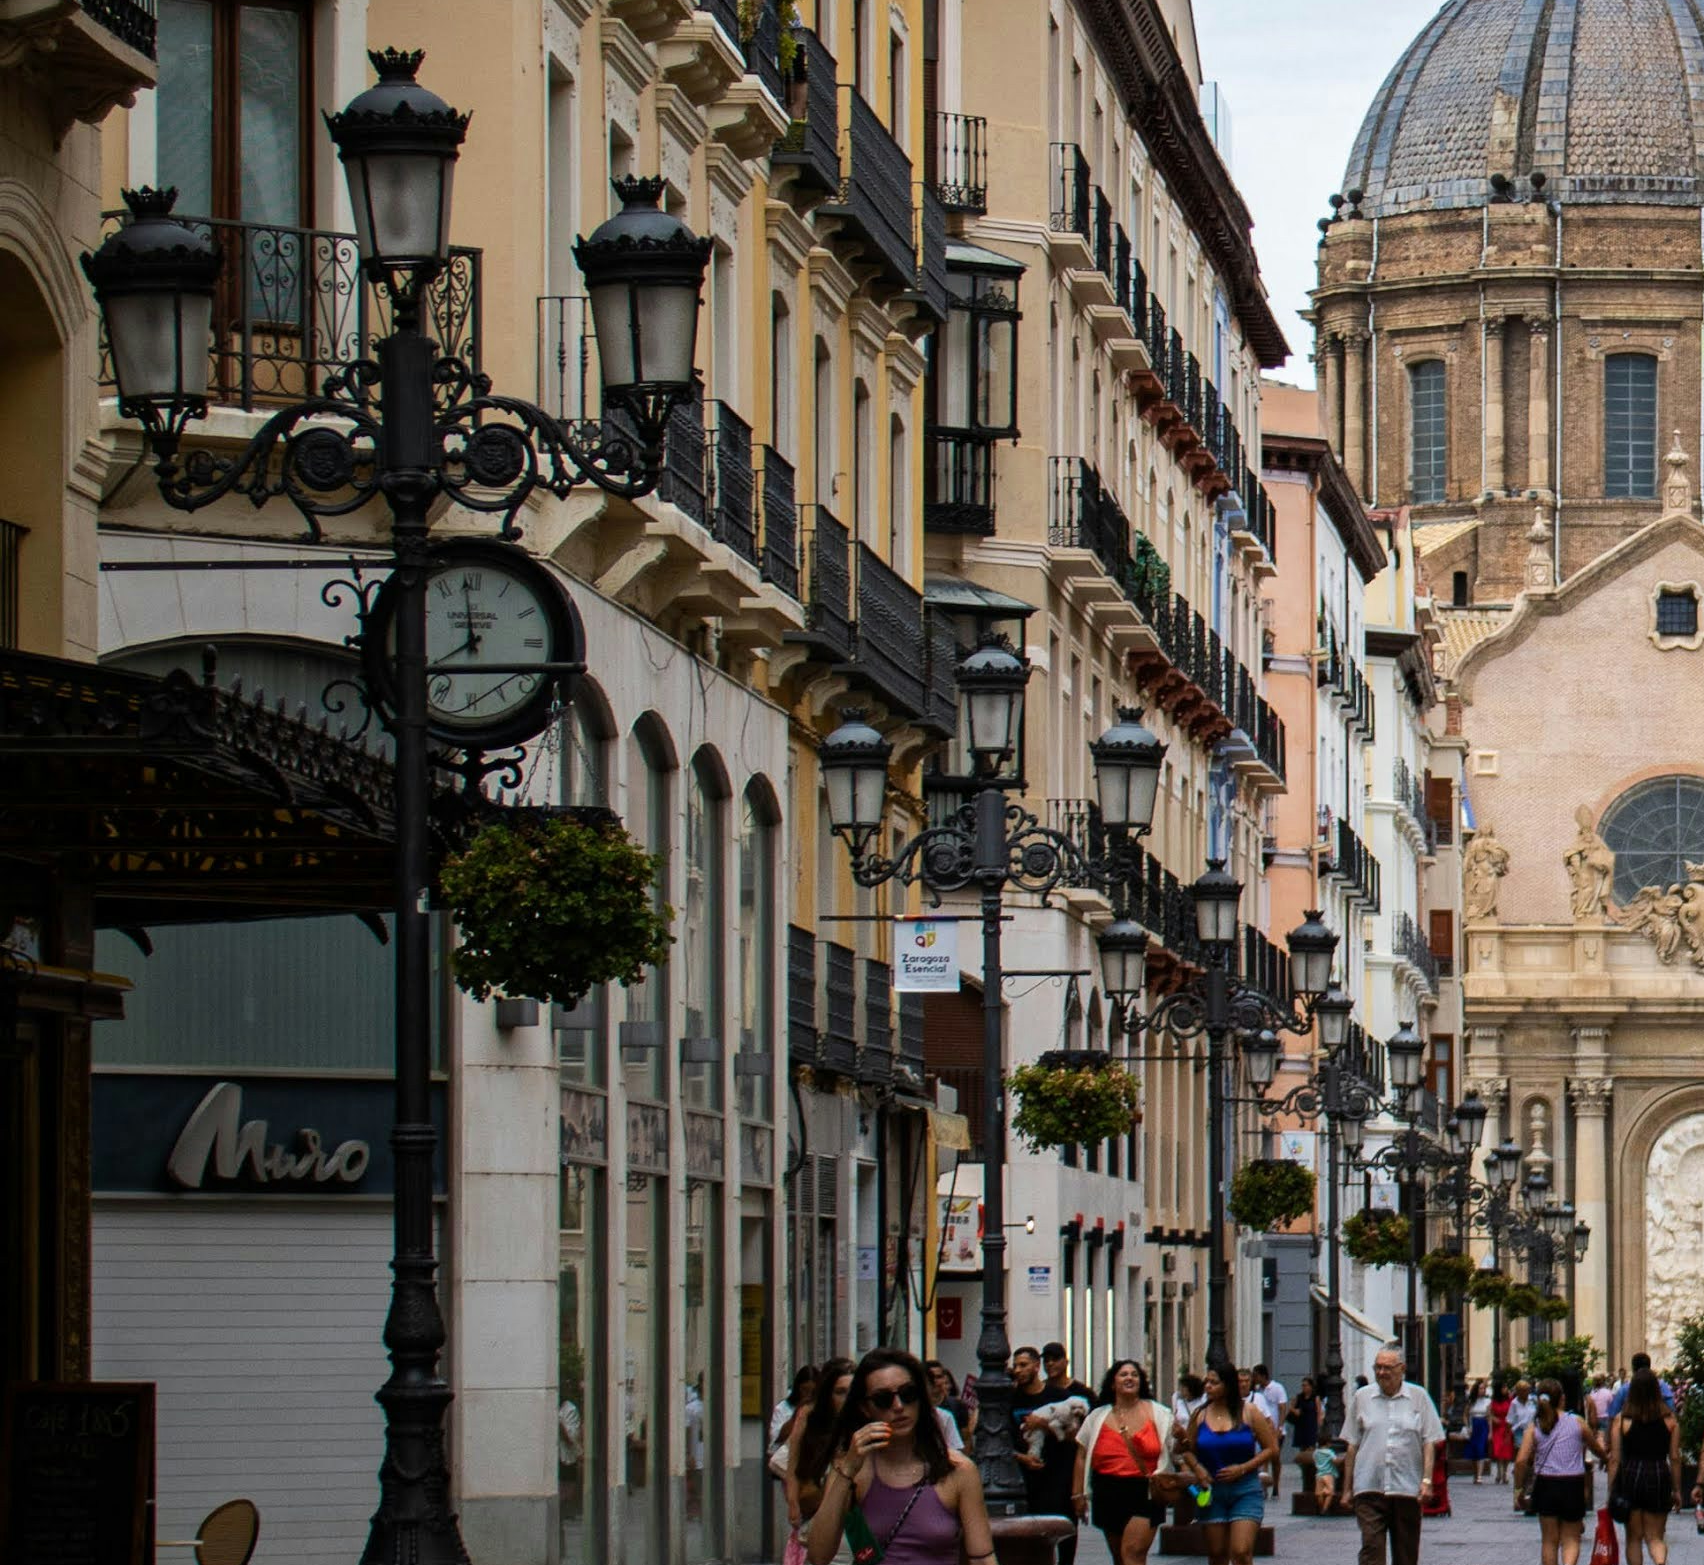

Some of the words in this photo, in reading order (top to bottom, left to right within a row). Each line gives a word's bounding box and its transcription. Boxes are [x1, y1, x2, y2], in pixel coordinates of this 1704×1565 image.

[447, 611, 498, 621] UNIVERSAL
[902, 953, 950, 965] Zaragoza
[905, 964, 947, 973] Esencial
[168, 1081, 371, 1189] Muro
